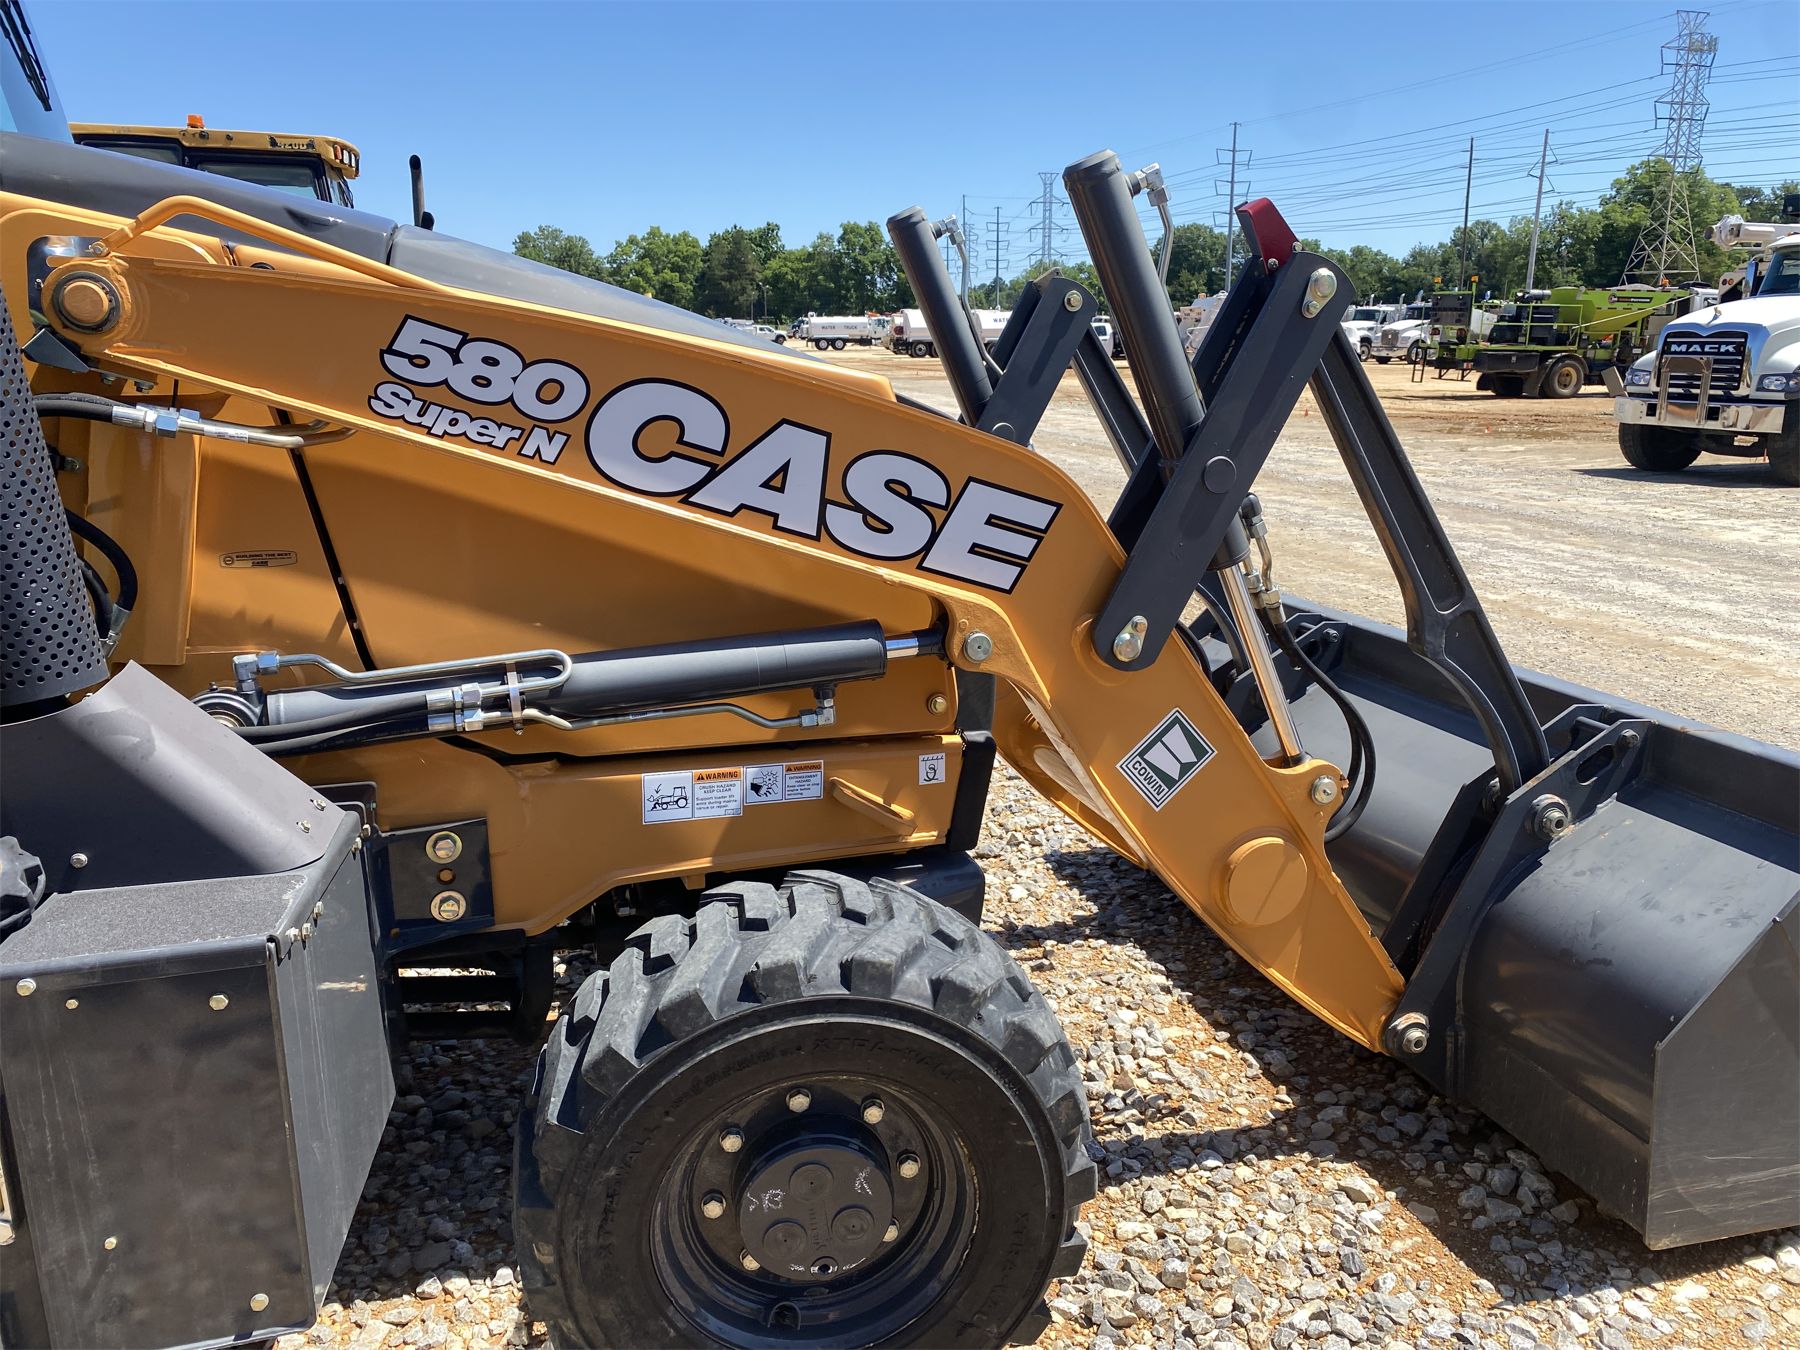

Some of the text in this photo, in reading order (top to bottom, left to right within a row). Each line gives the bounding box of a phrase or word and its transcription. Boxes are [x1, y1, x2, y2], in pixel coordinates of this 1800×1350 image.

[1670, 344, 1737, 353] MACK
[380, 313, 591, 424] 580
[367, 381, 572, 465] Super N
[584, 377, 1064, 594] CASE
[705, 770, 739, 780] WARNING
[794, 764, 822, 772] WARNING
[1131, 760, 1167, 797] COWIN
